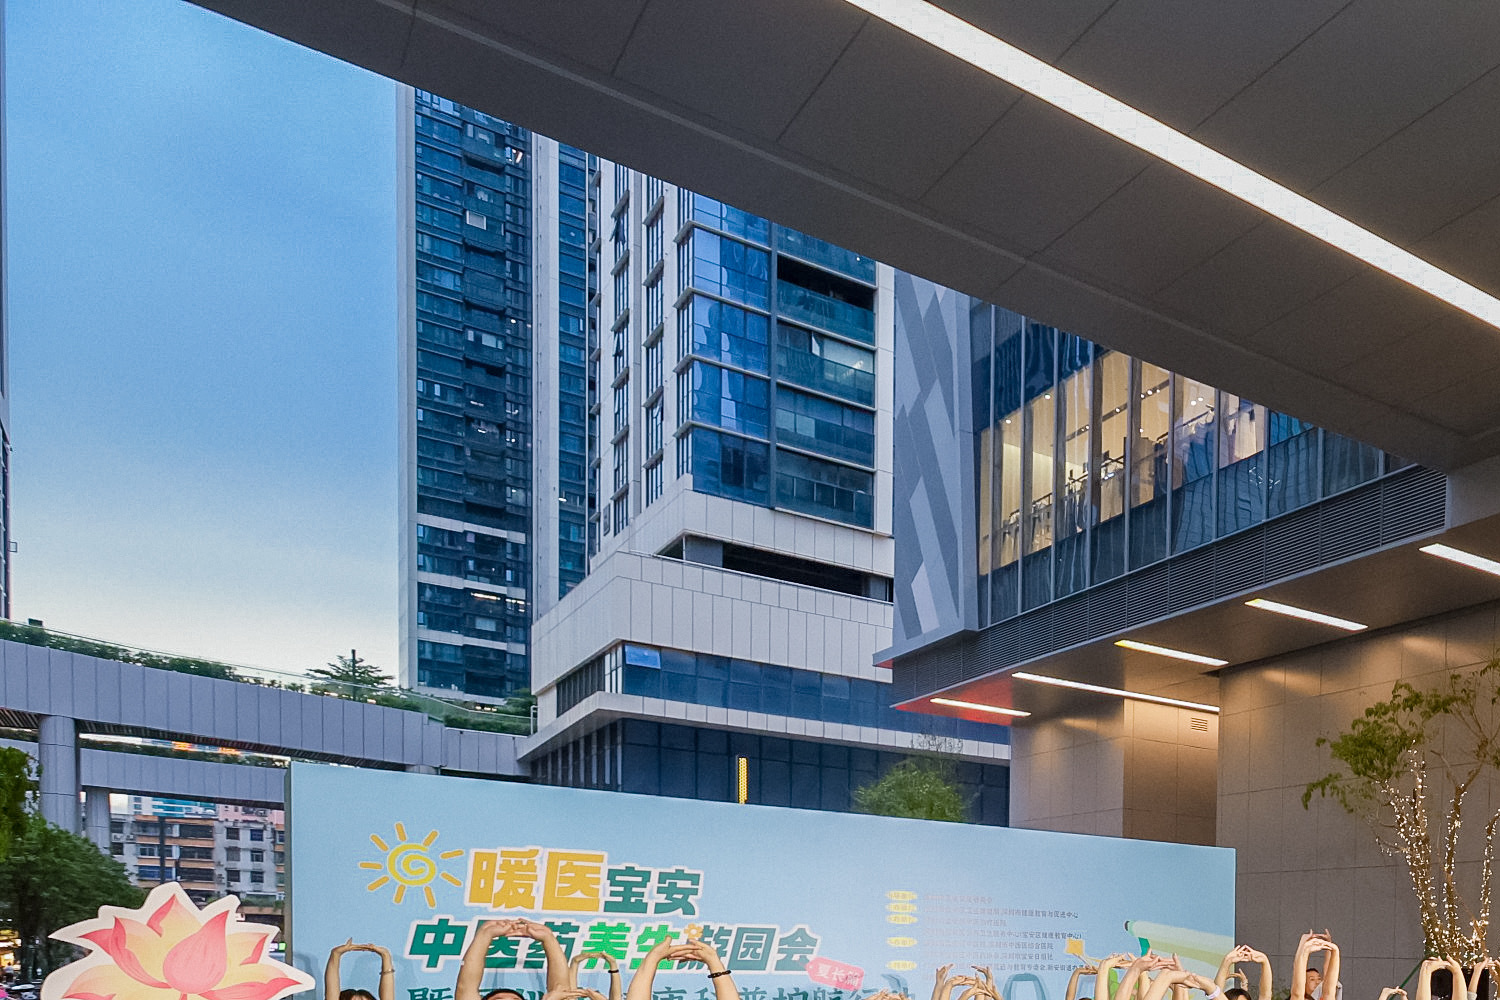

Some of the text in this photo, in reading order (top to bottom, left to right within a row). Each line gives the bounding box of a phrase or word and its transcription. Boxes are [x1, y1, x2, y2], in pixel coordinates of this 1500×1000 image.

[467, 848, 701, 916] 暖医宝安
[815, 962, 860, 987] 夏长篇
